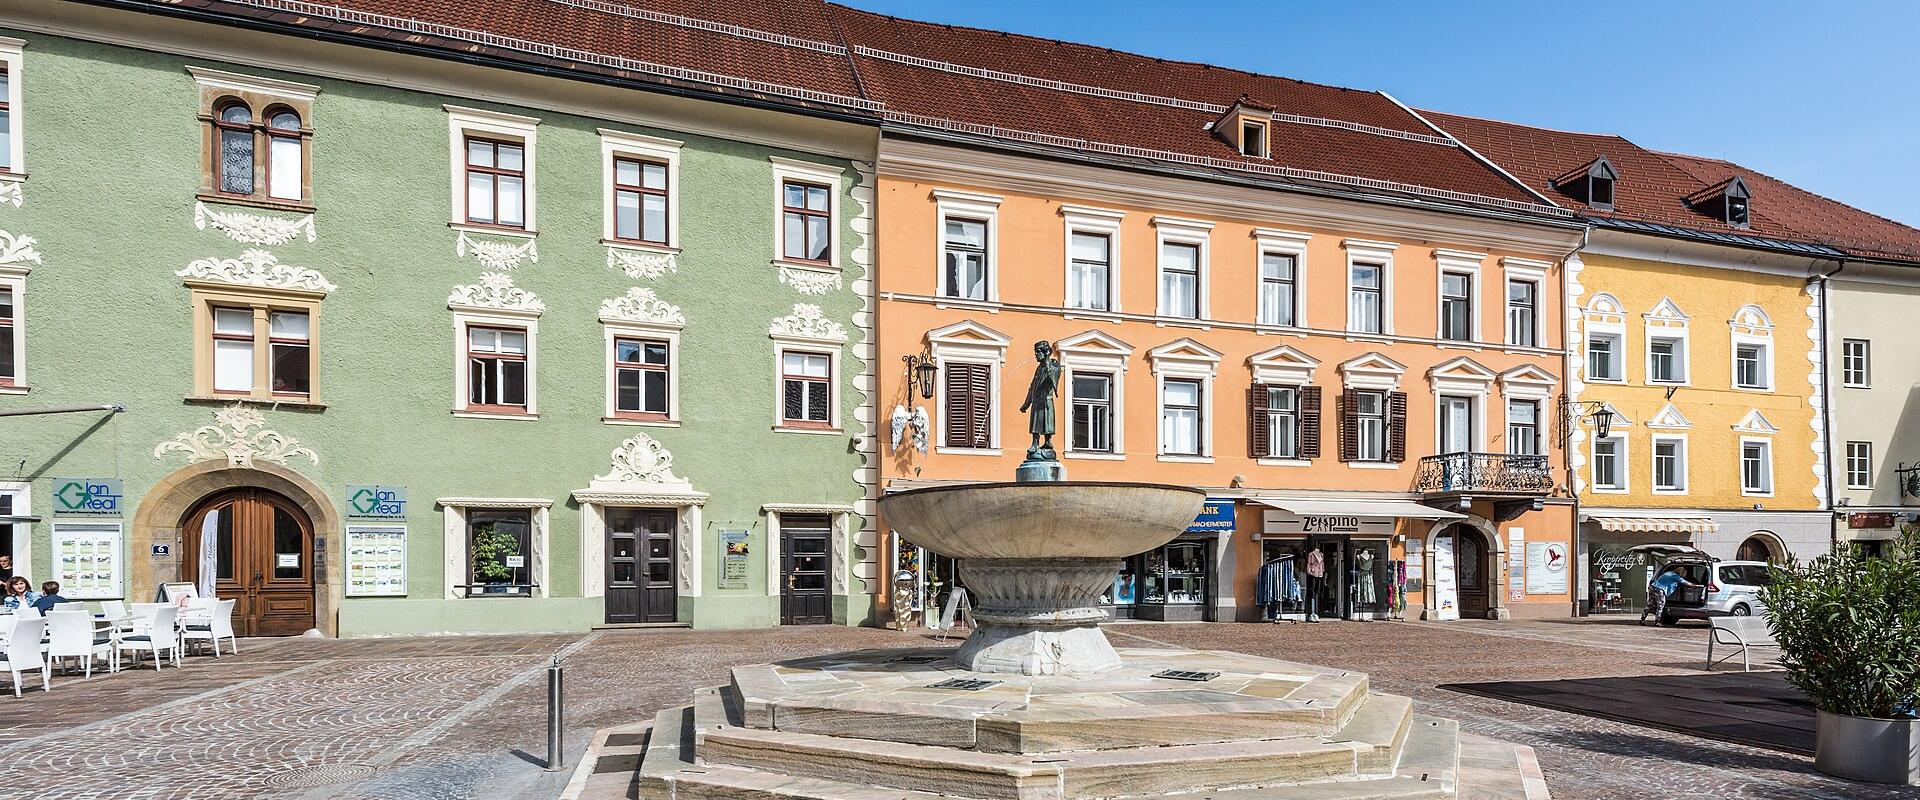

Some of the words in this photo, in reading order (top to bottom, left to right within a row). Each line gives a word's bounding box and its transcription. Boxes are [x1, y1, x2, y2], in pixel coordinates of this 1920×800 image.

[83, 496, 116, 509] Real
[372, 502, 401, 514] Real
[1199, 506, 1219, 514] ANK
